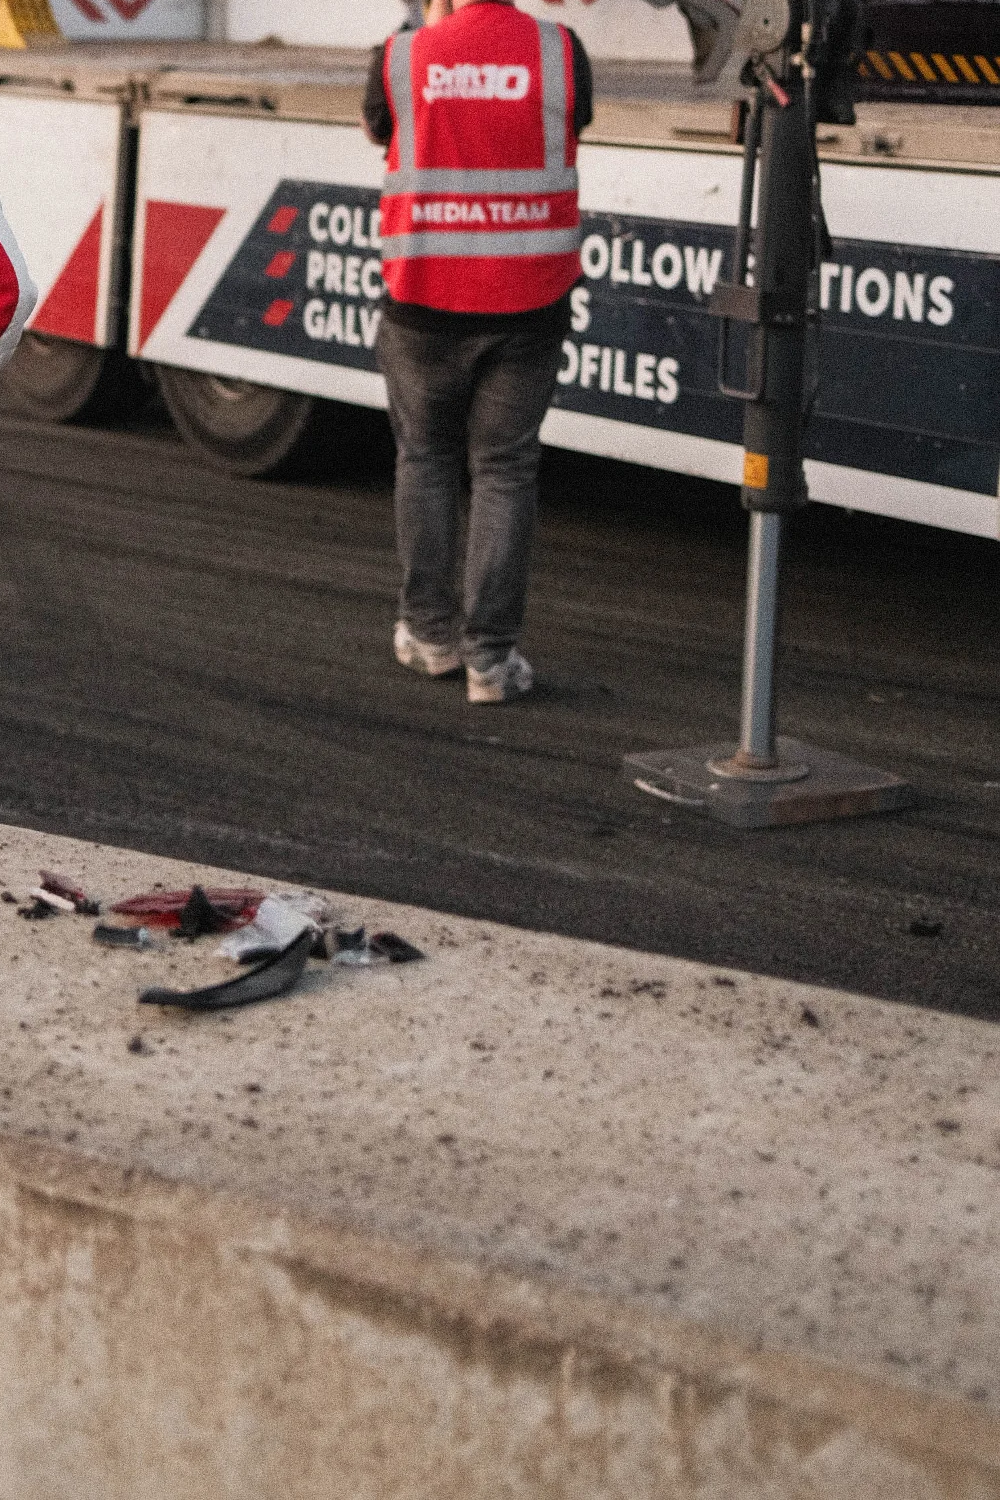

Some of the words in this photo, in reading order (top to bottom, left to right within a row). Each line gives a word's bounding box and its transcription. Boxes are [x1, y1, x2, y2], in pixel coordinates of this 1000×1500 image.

[412, 202, 486, 224] MEDIA
[487, 201, 551, 223] TEAM
[579, 234, 723, 295] OLLOW
